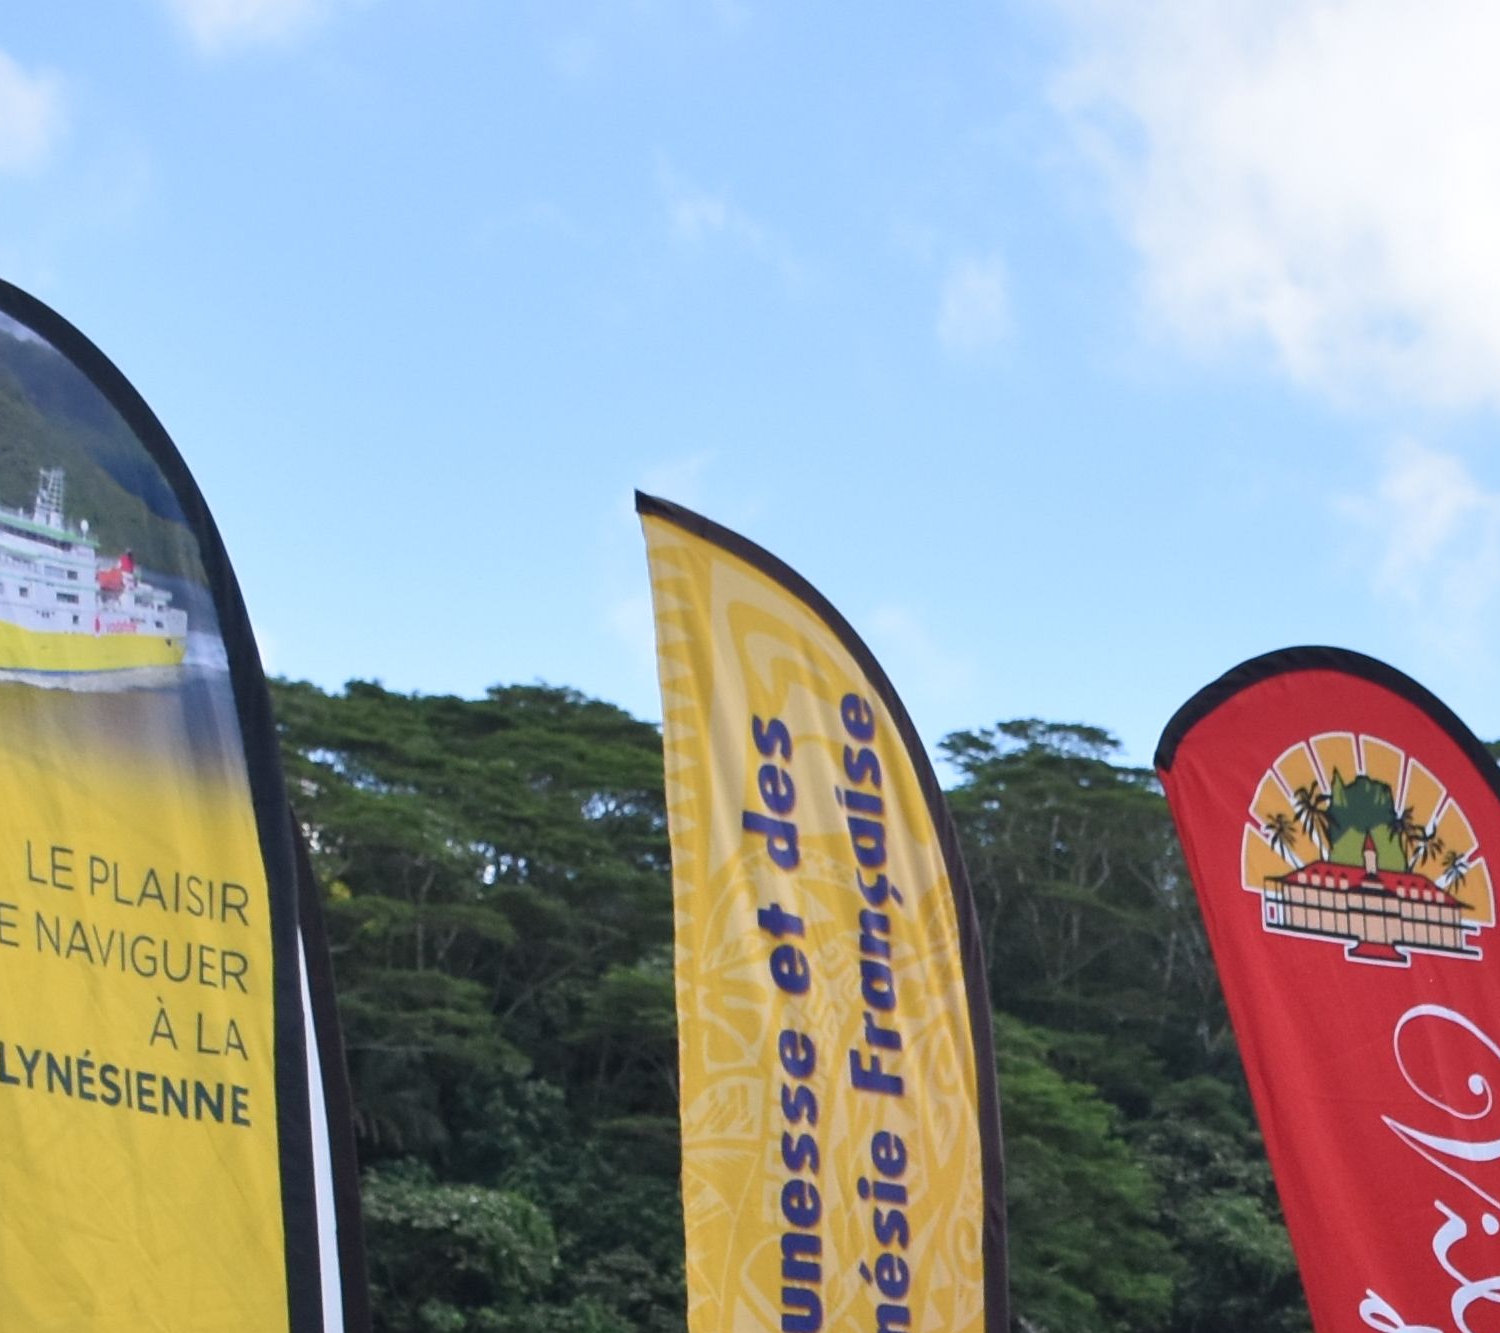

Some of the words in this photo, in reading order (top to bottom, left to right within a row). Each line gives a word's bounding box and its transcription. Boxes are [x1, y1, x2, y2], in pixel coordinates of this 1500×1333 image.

[742, 713, 799, 869] des
[25, 840, 73, 889] LE
[90, 854, 249, 928] PLAISIR
[836, 691, 906, 1096] Française
[35, 914, 249, 993] NAVIGUER
[757, 901, 812, 995] et
[149, 998, 178, 1049] À
[196, 1012, 248, 1062] LA
